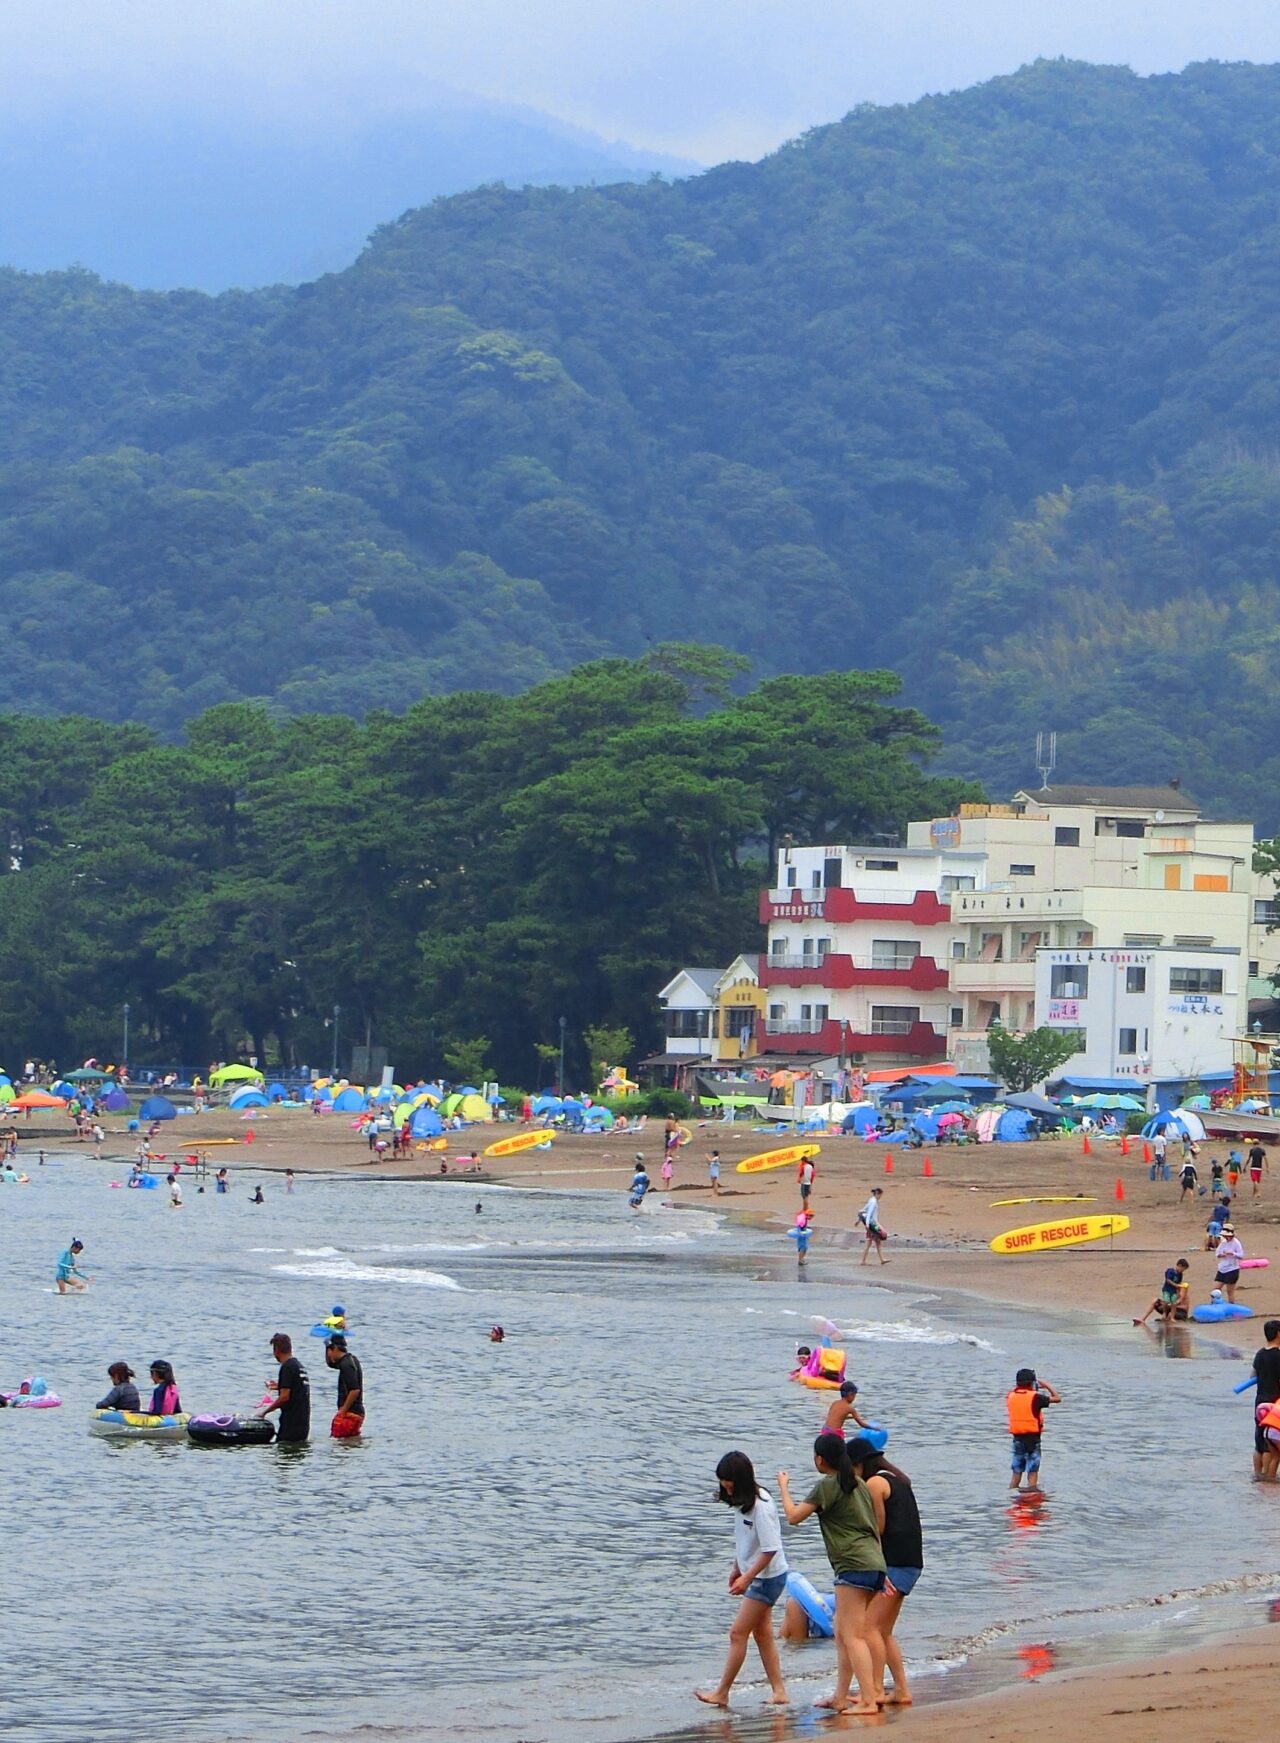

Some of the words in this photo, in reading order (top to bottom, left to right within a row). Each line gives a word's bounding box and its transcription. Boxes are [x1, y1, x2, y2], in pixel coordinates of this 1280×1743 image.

[746, 1159, 763, 1170] SURF
[767, 1151, 796, 1164] RESCUE
[1005, 1232, 1036, 1249] SURF
[1041, 1223, 1089, 1242] RESCUE
